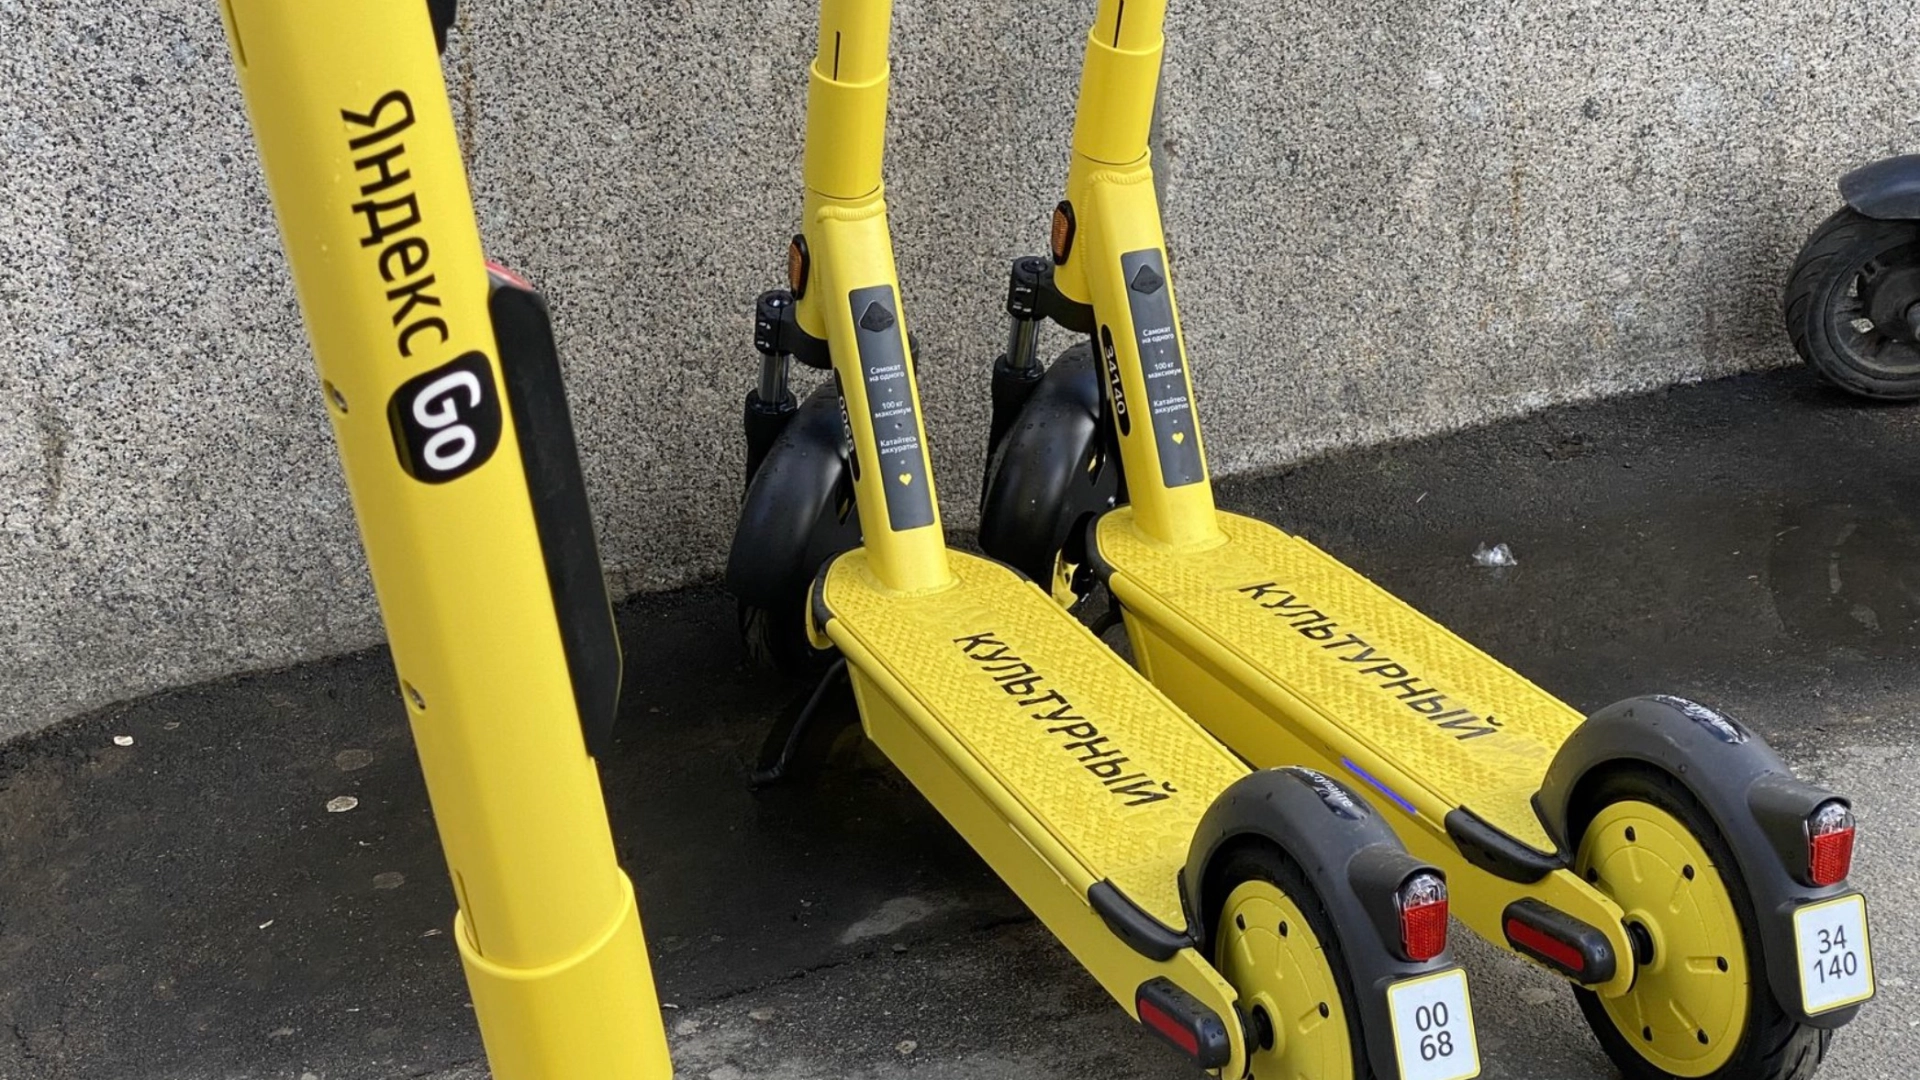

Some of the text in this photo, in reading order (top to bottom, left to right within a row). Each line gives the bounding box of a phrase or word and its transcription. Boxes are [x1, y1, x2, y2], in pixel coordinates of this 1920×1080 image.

[340, 89, 482, 471] Яндекс Go
[1142, 326, 1171, 336] Самокат
[1151, 333, 1175, 343] одного
[870, 364, 901, 375] Самокат
[1154, 362, 1167, 370] 100
[879, 371, 905, 381] одного
[1147, 368, 1182, 379] максимум
[1105, 345, 1126, 415] 34140
[882, 401, 895, 410] 100
[1153, 395, 1187, 407] Катайтесь
[874, 406, 912, 418] максимум
[1154, 402, 1189, 414] аккуратно
[880, 435, 917, 447] Катайтесь
[881, 443, 918, 455] аккуратно
[1238, 581, 1504, 741] КУЛЬТУРНЫЙ
[952, 631, 1179, 807] КУЛЬТУРНЫЙ
[1817, 924, 1848, 955] 34
[1813, 951, 1858, 984] 140
[1415, 1001, 1449, 1032] 00
[1420, 1030, 1454, 1061] 68
